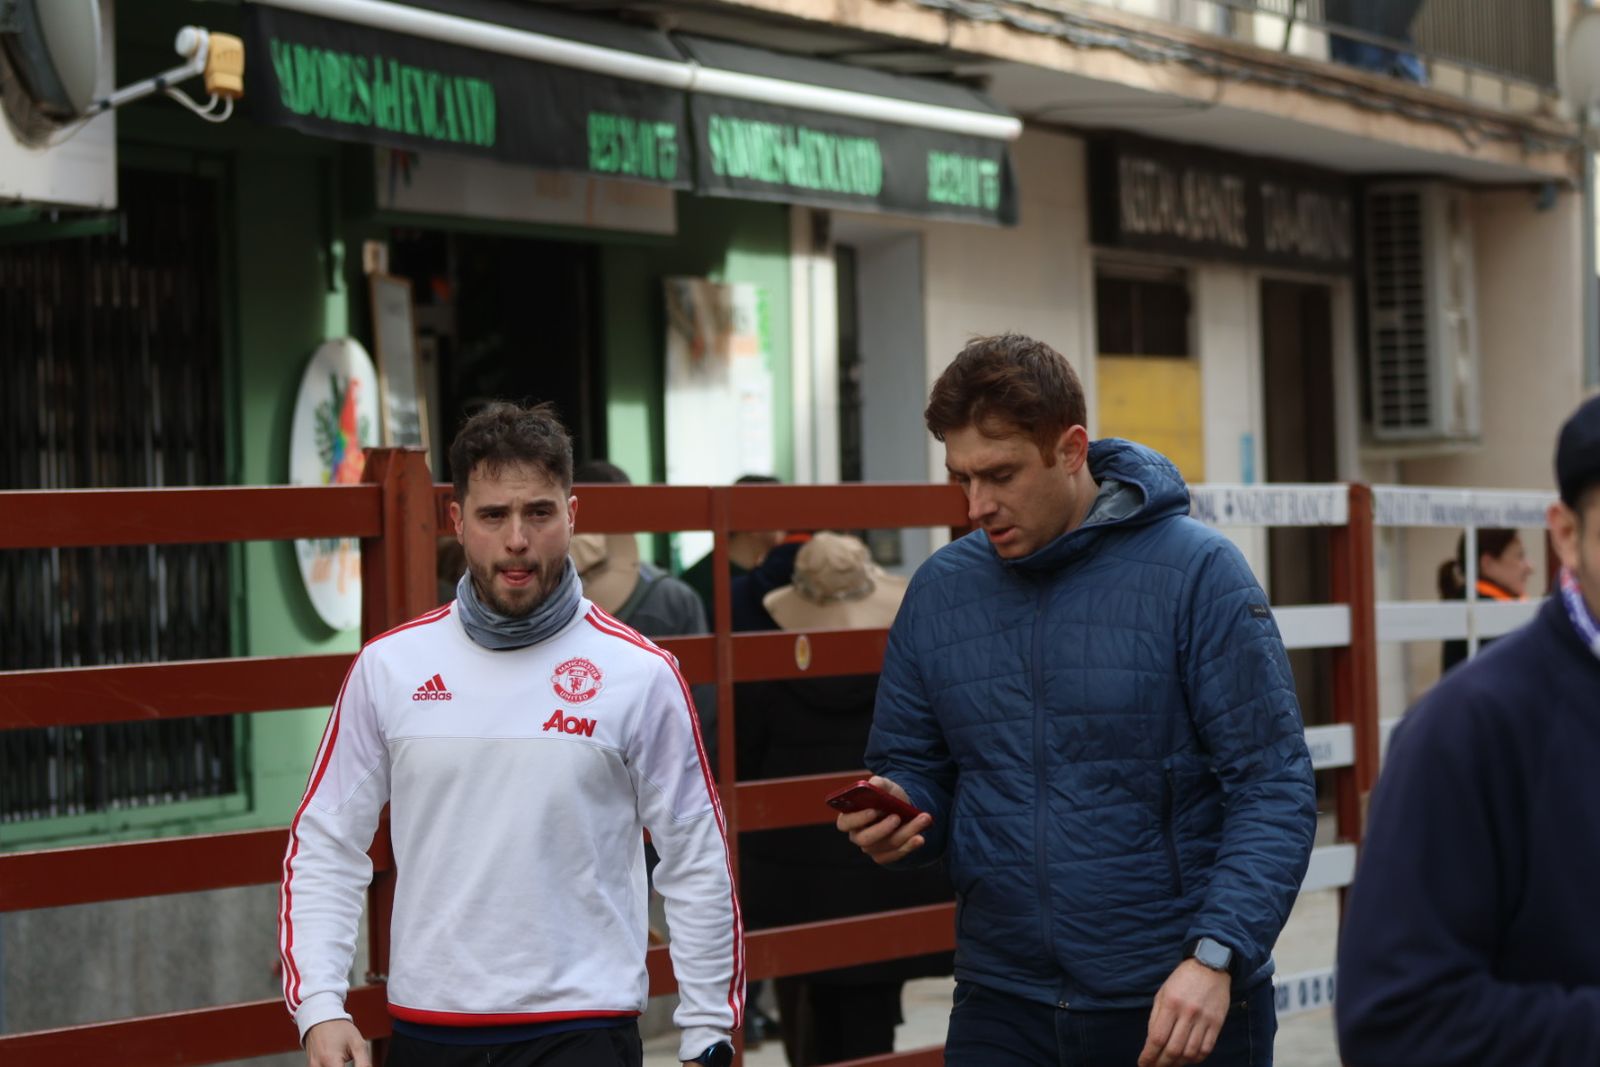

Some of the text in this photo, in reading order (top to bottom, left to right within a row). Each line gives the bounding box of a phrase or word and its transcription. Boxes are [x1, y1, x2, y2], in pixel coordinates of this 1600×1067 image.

[401, 64, 496, 147] ENCANTO
[558, 660, 600, 681] MANCHESTER
[412, 690, 452, 701] adidas
[559, 690, 589, 702] UNITED
